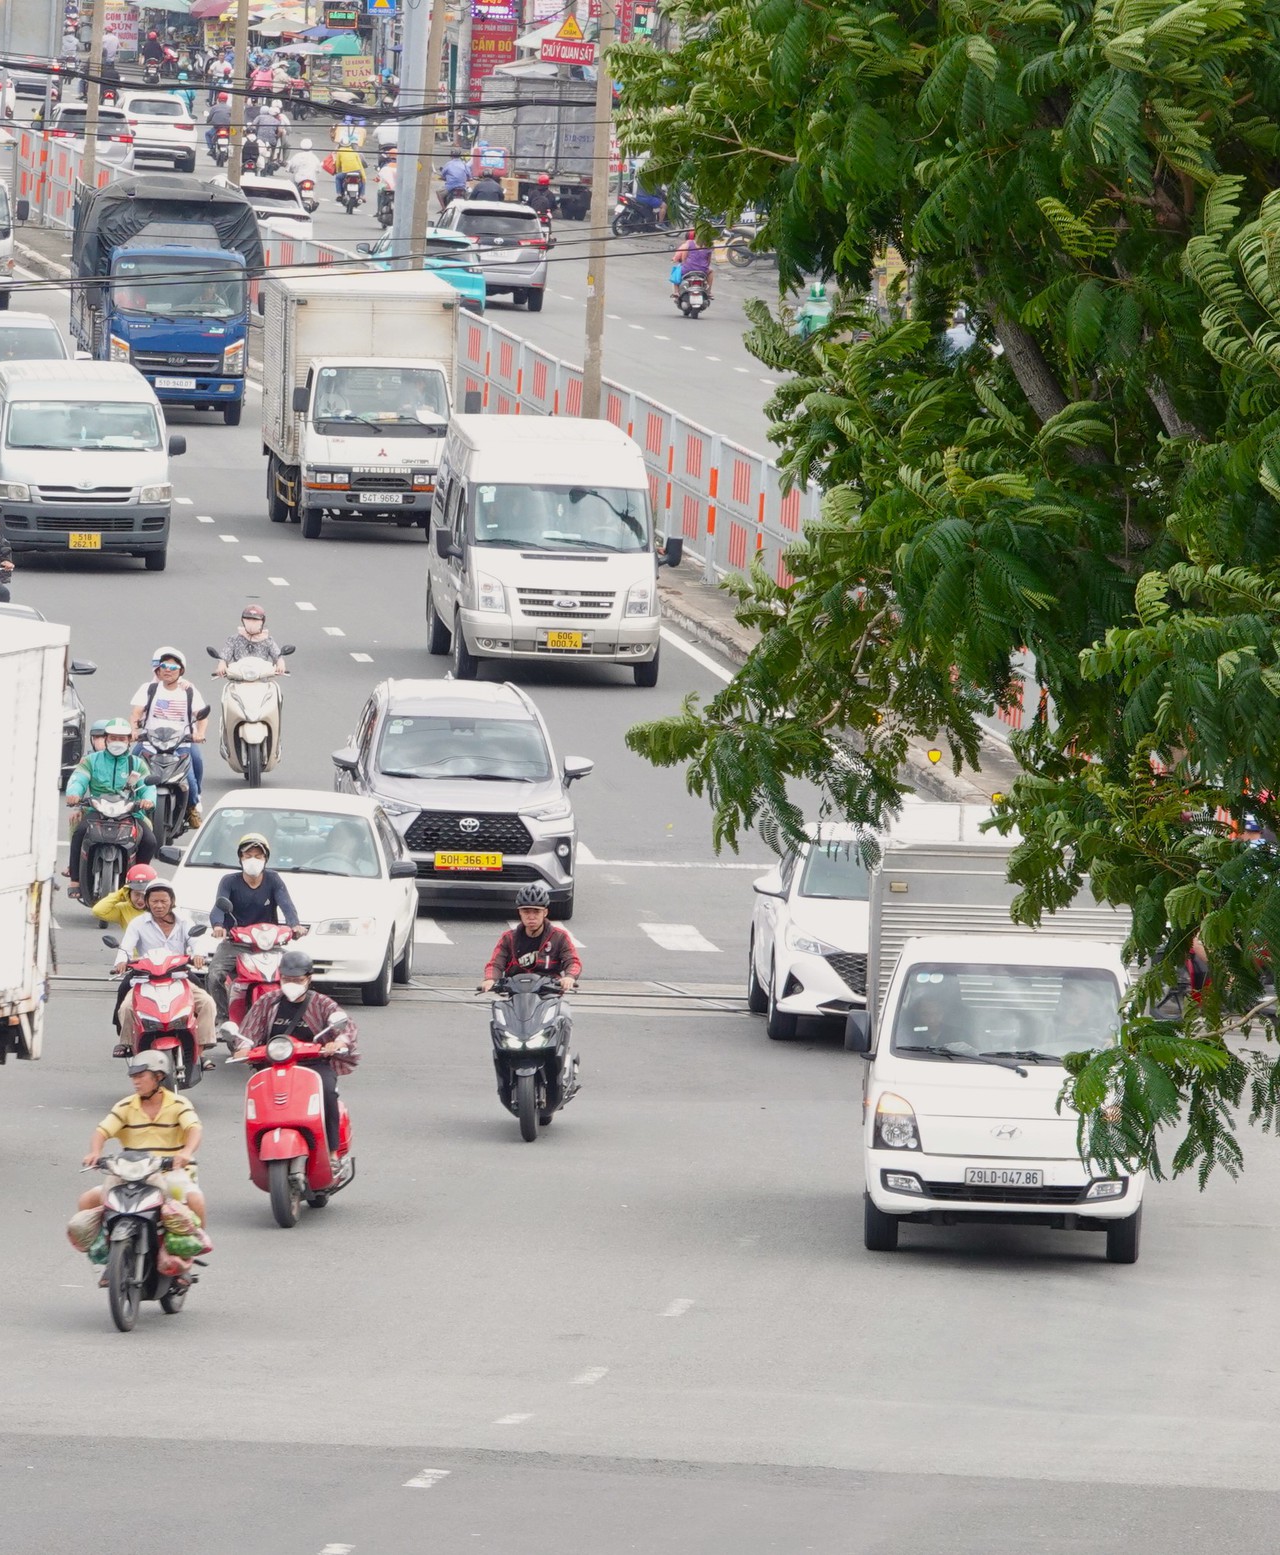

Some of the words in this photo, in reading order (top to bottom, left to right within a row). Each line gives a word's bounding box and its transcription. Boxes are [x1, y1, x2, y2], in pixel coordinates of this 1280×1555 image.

[542, 41, 555, 57] CHÚ
[561, 45, 579, 60] QUAN
[579, 45, 594, 62] SÁT
[362, 494, 400, 503] 54T-9662
[557, 632, 573, 640] 60G
[550, 640, 578, 648] 000.74
[440, 855, 497, 865] 50H-366.13
[969, 1170, 1038, 1185] 29LD-047.86
